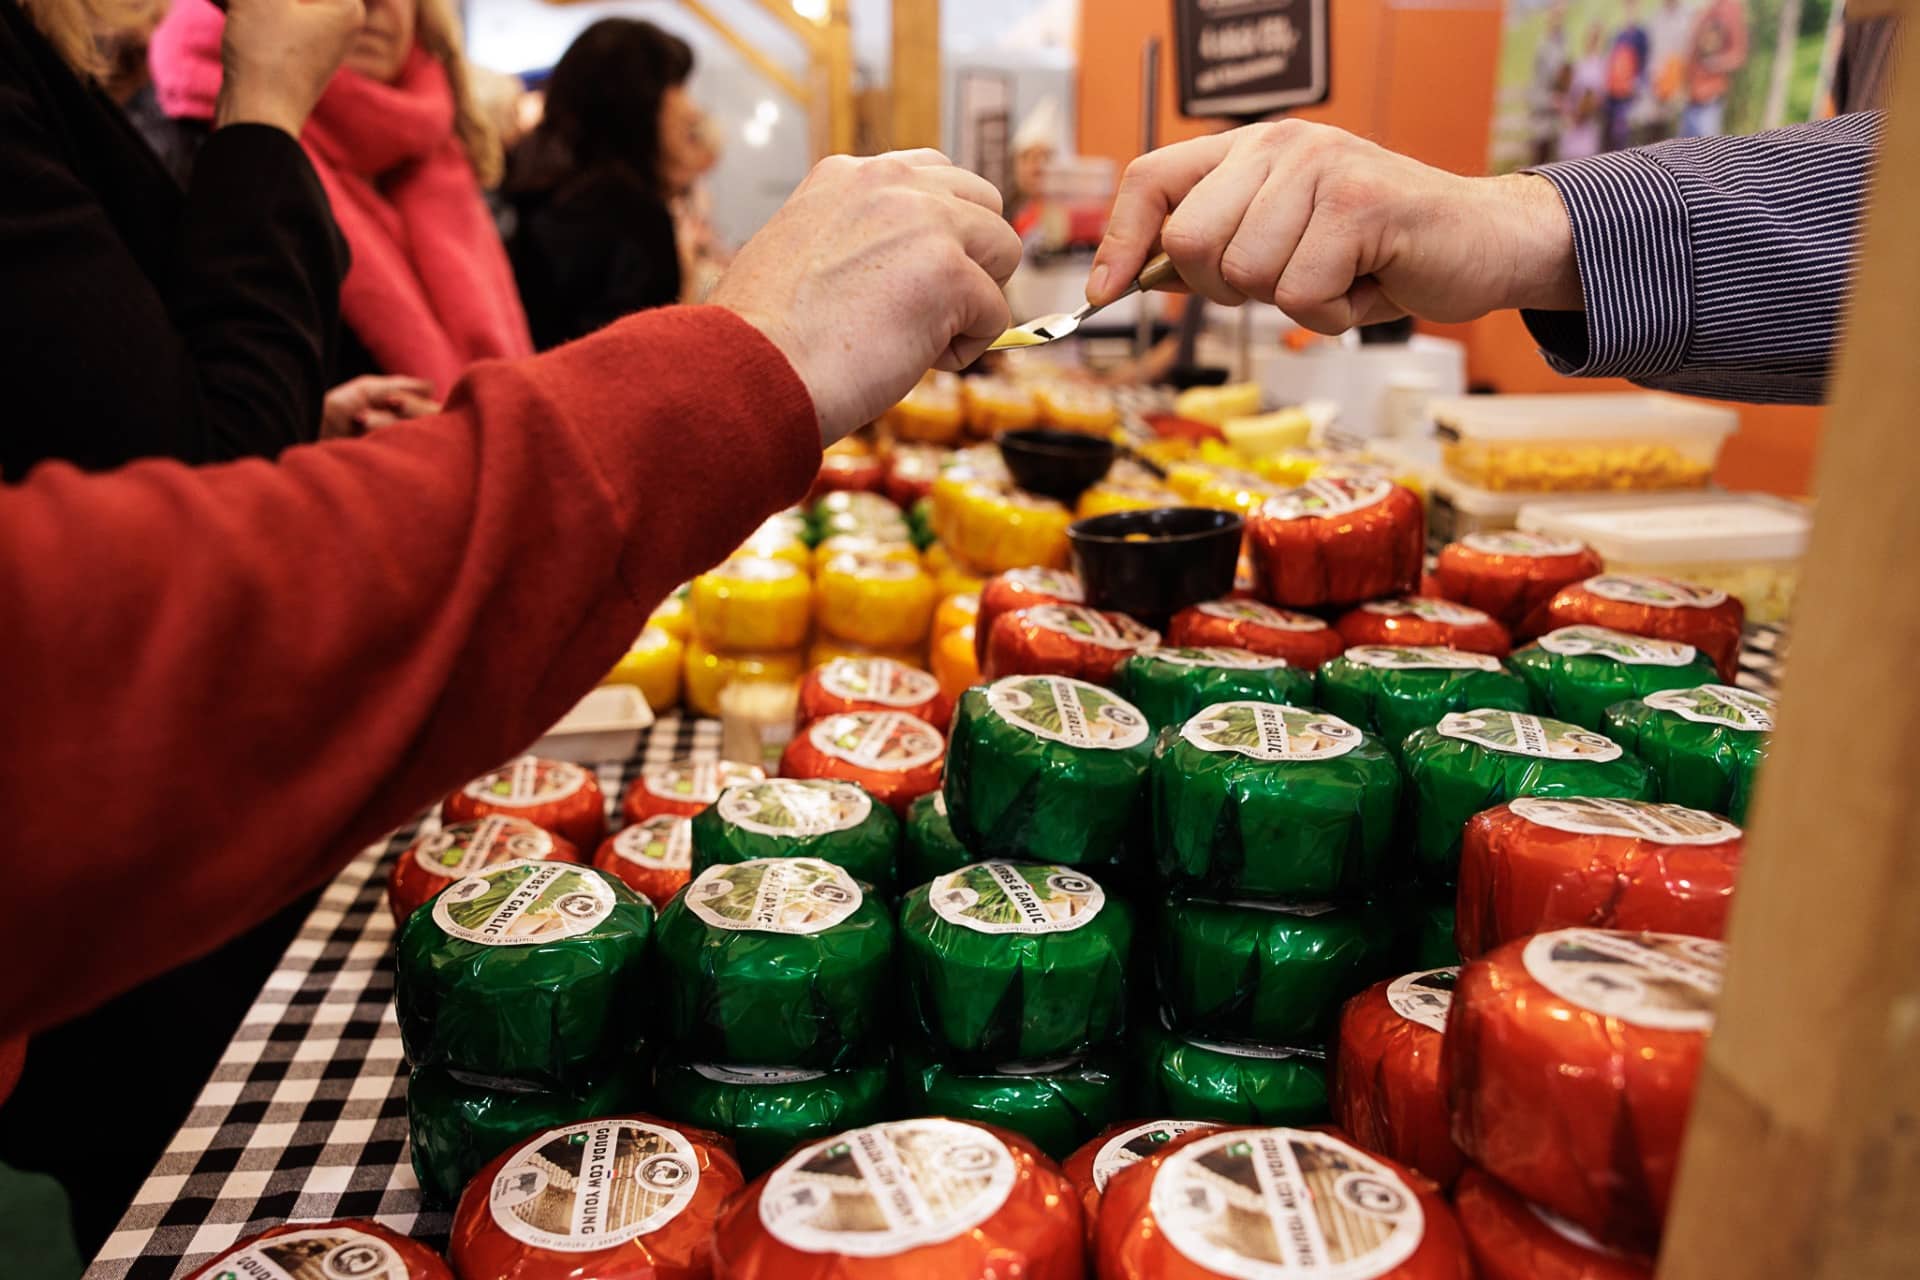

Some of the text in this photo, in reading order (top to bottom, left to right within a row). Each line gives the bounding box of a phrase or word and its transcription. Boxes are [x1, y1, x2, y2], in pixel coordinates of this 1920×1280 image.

[484, 899, 524, 935] GARLIC
[1014, 892, 1046, 924] GARLIC
[581, 1128, 610, 1235] GOUDA COW YOUNG
[1260, 1138, 1287, 1178] GOUDA
[1275, 1182, 1297, 1210] COW
[236, 1256, 278, 1280] GOUD
